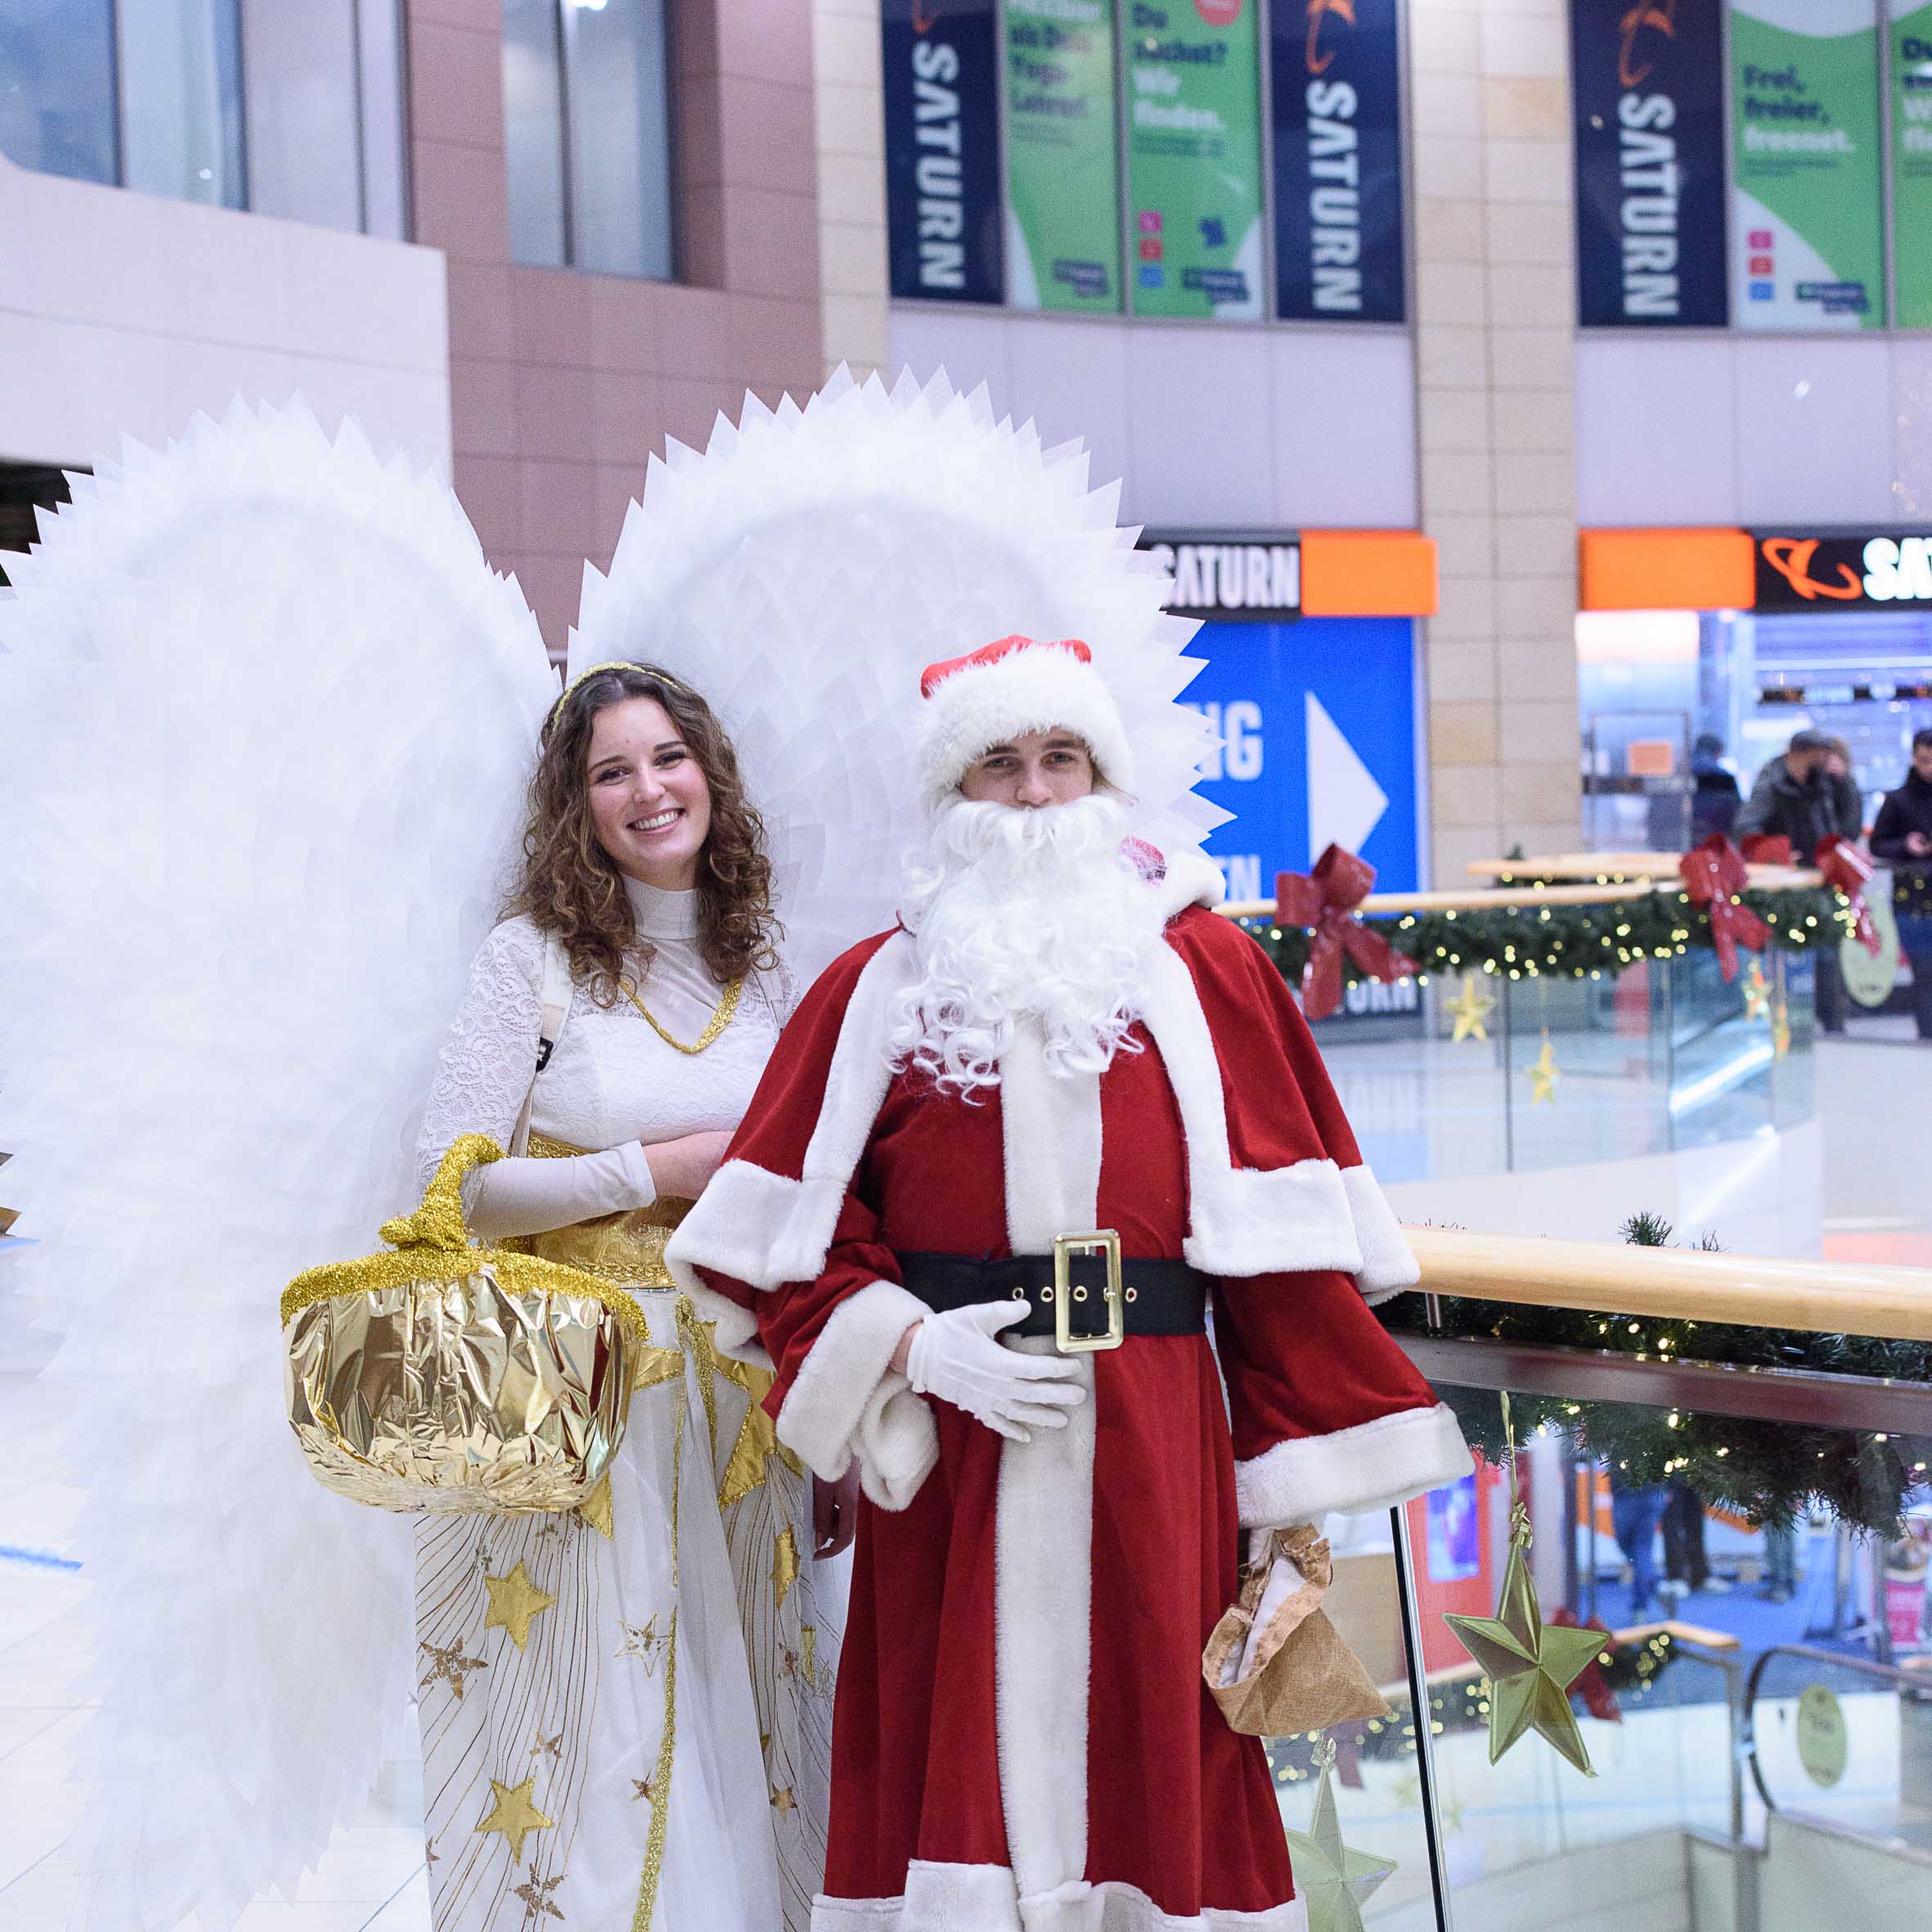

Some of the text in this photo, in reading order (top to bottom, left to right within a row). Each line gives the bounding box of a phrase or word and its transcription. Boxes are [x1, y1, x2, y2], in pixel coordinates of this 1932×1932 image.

[912, 42, 965, 289] SATURN
[1306, 81, 1363, 312] SATURN
[1618, 92, 1679, 317] SATURN
